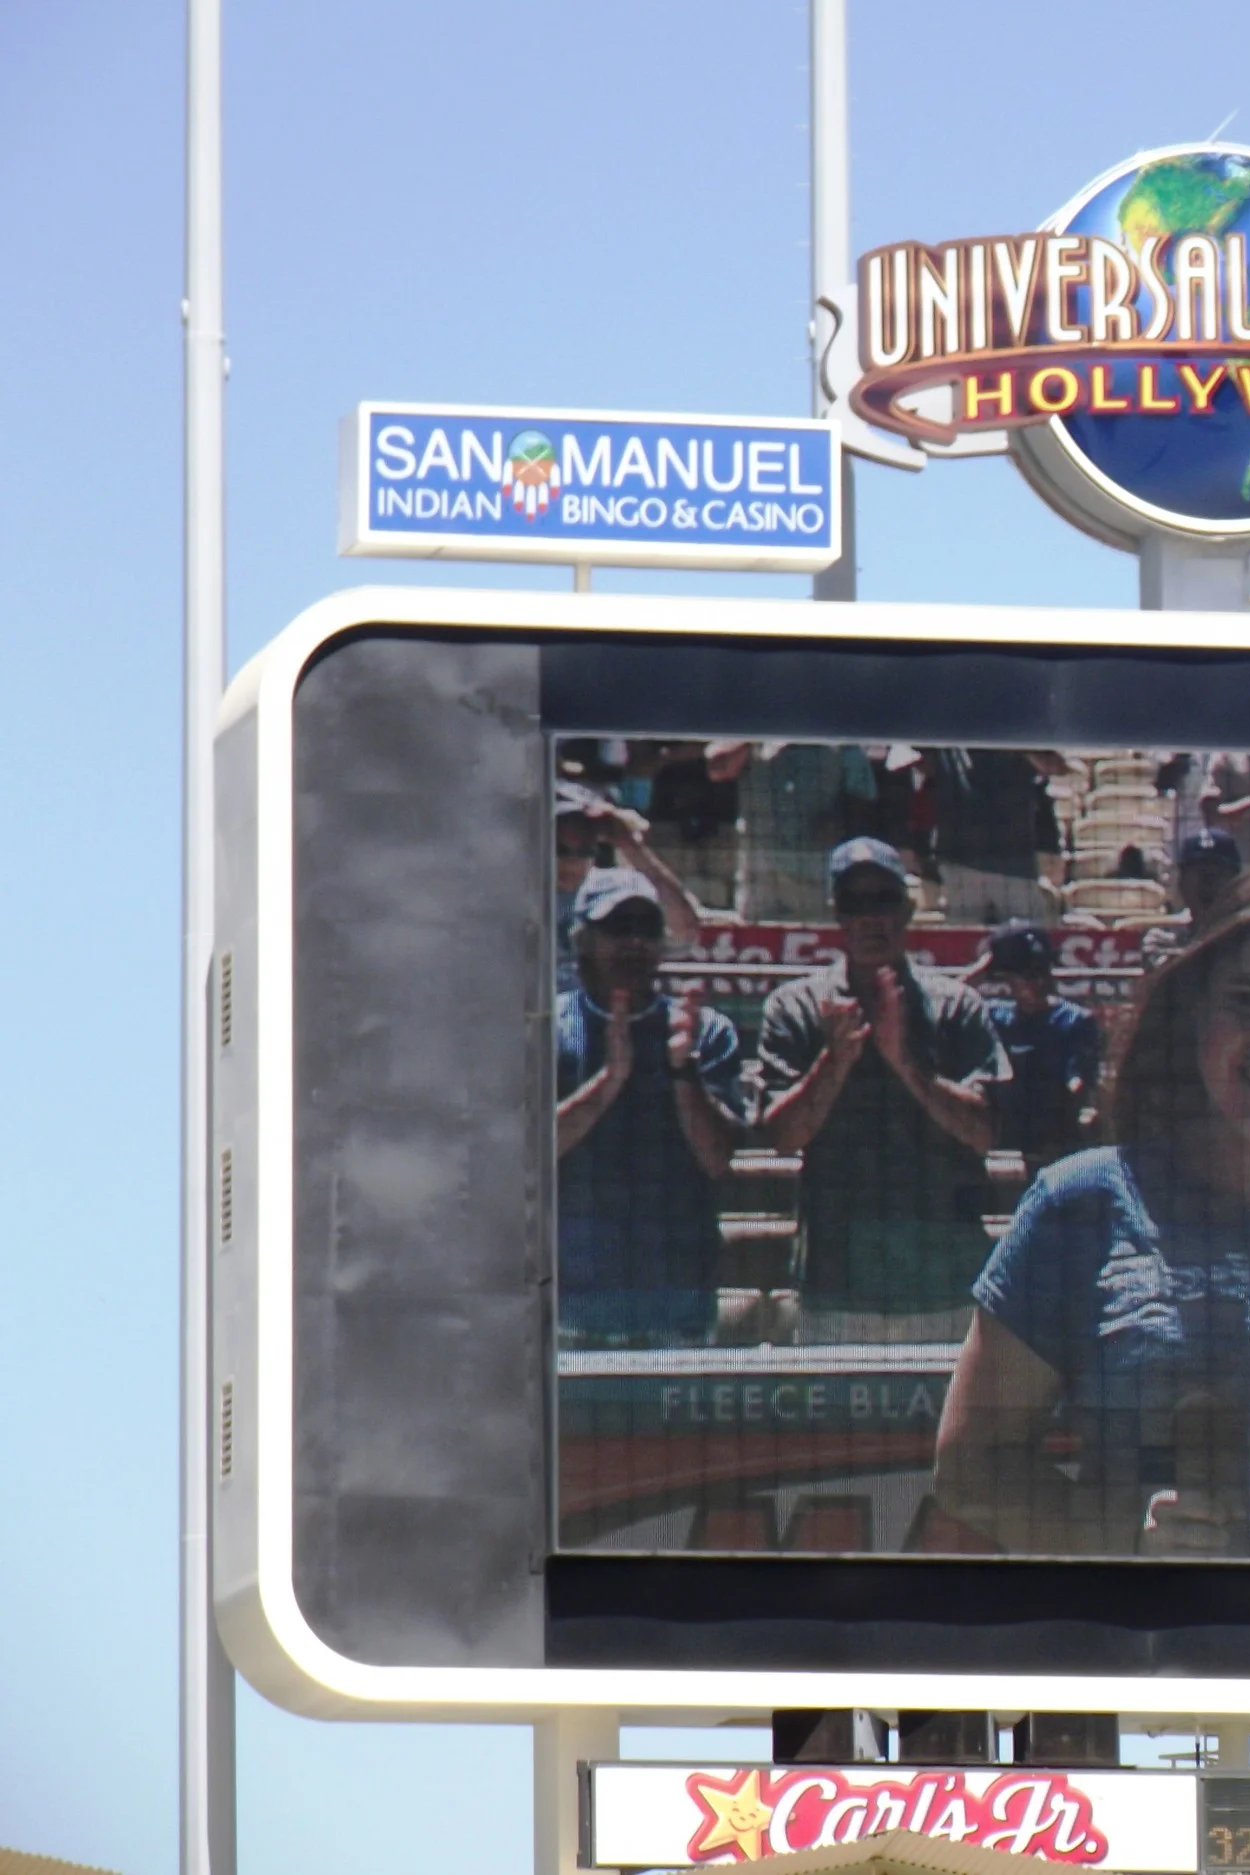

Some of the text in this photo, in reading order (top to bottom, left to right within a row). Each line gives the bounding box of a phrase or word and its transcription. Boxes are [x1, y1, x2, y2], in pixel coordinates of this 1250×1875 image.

[375, 424, 823, 496] SAN MANUEL
[376, 486, 502, 521] INDIAN
[562, 496, 667, 527] BINGO
[702, 500, 825, 534] CASINO
[660, 1383, 943, 1421] FLEECE BLA
[768, 1776, 1098, 1860] Carl's Jr.
